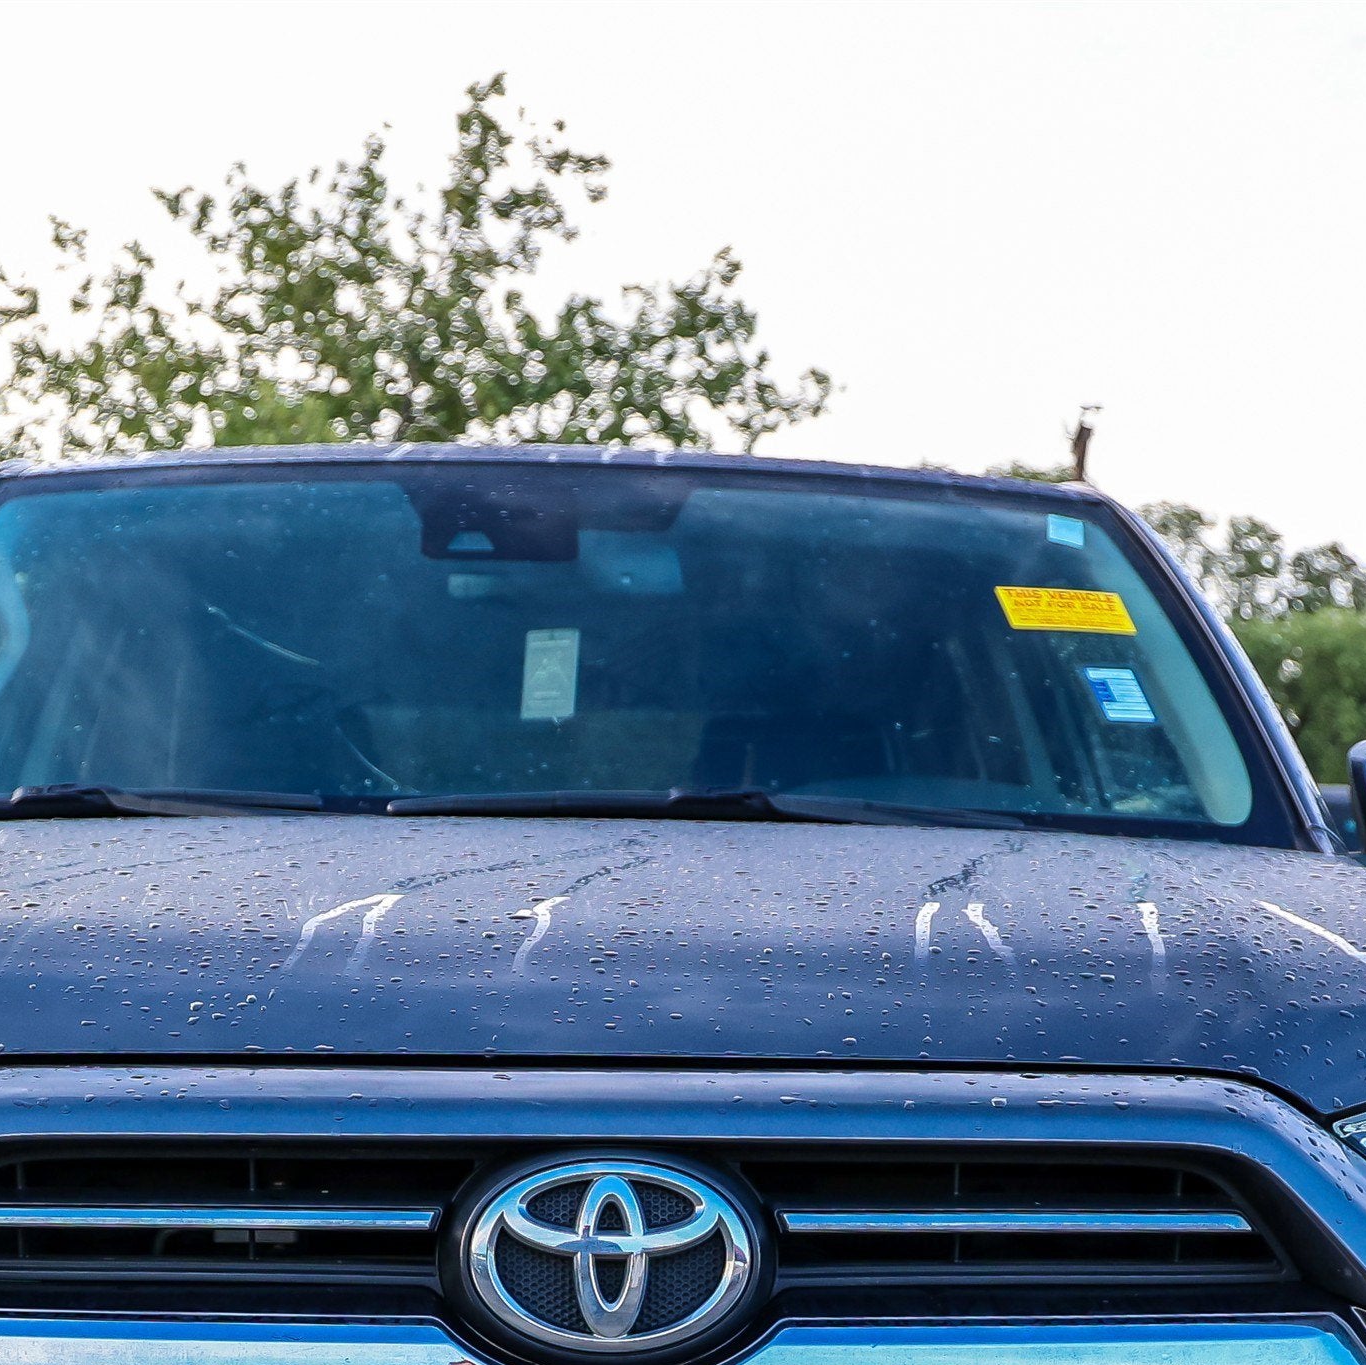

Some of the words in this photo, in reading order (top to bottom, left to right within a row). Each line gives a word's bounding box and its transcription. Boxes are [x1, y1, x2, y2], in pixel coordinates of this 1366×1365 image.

[1005, 588, 1042, 599] THIS
[1046, 590, 1117, 603] VEHICLE
[1013, 599, 1042, 607] NOT
[1047, 600, 1076, 609] FOR
[1081, 602, 1117, 612] SALE
